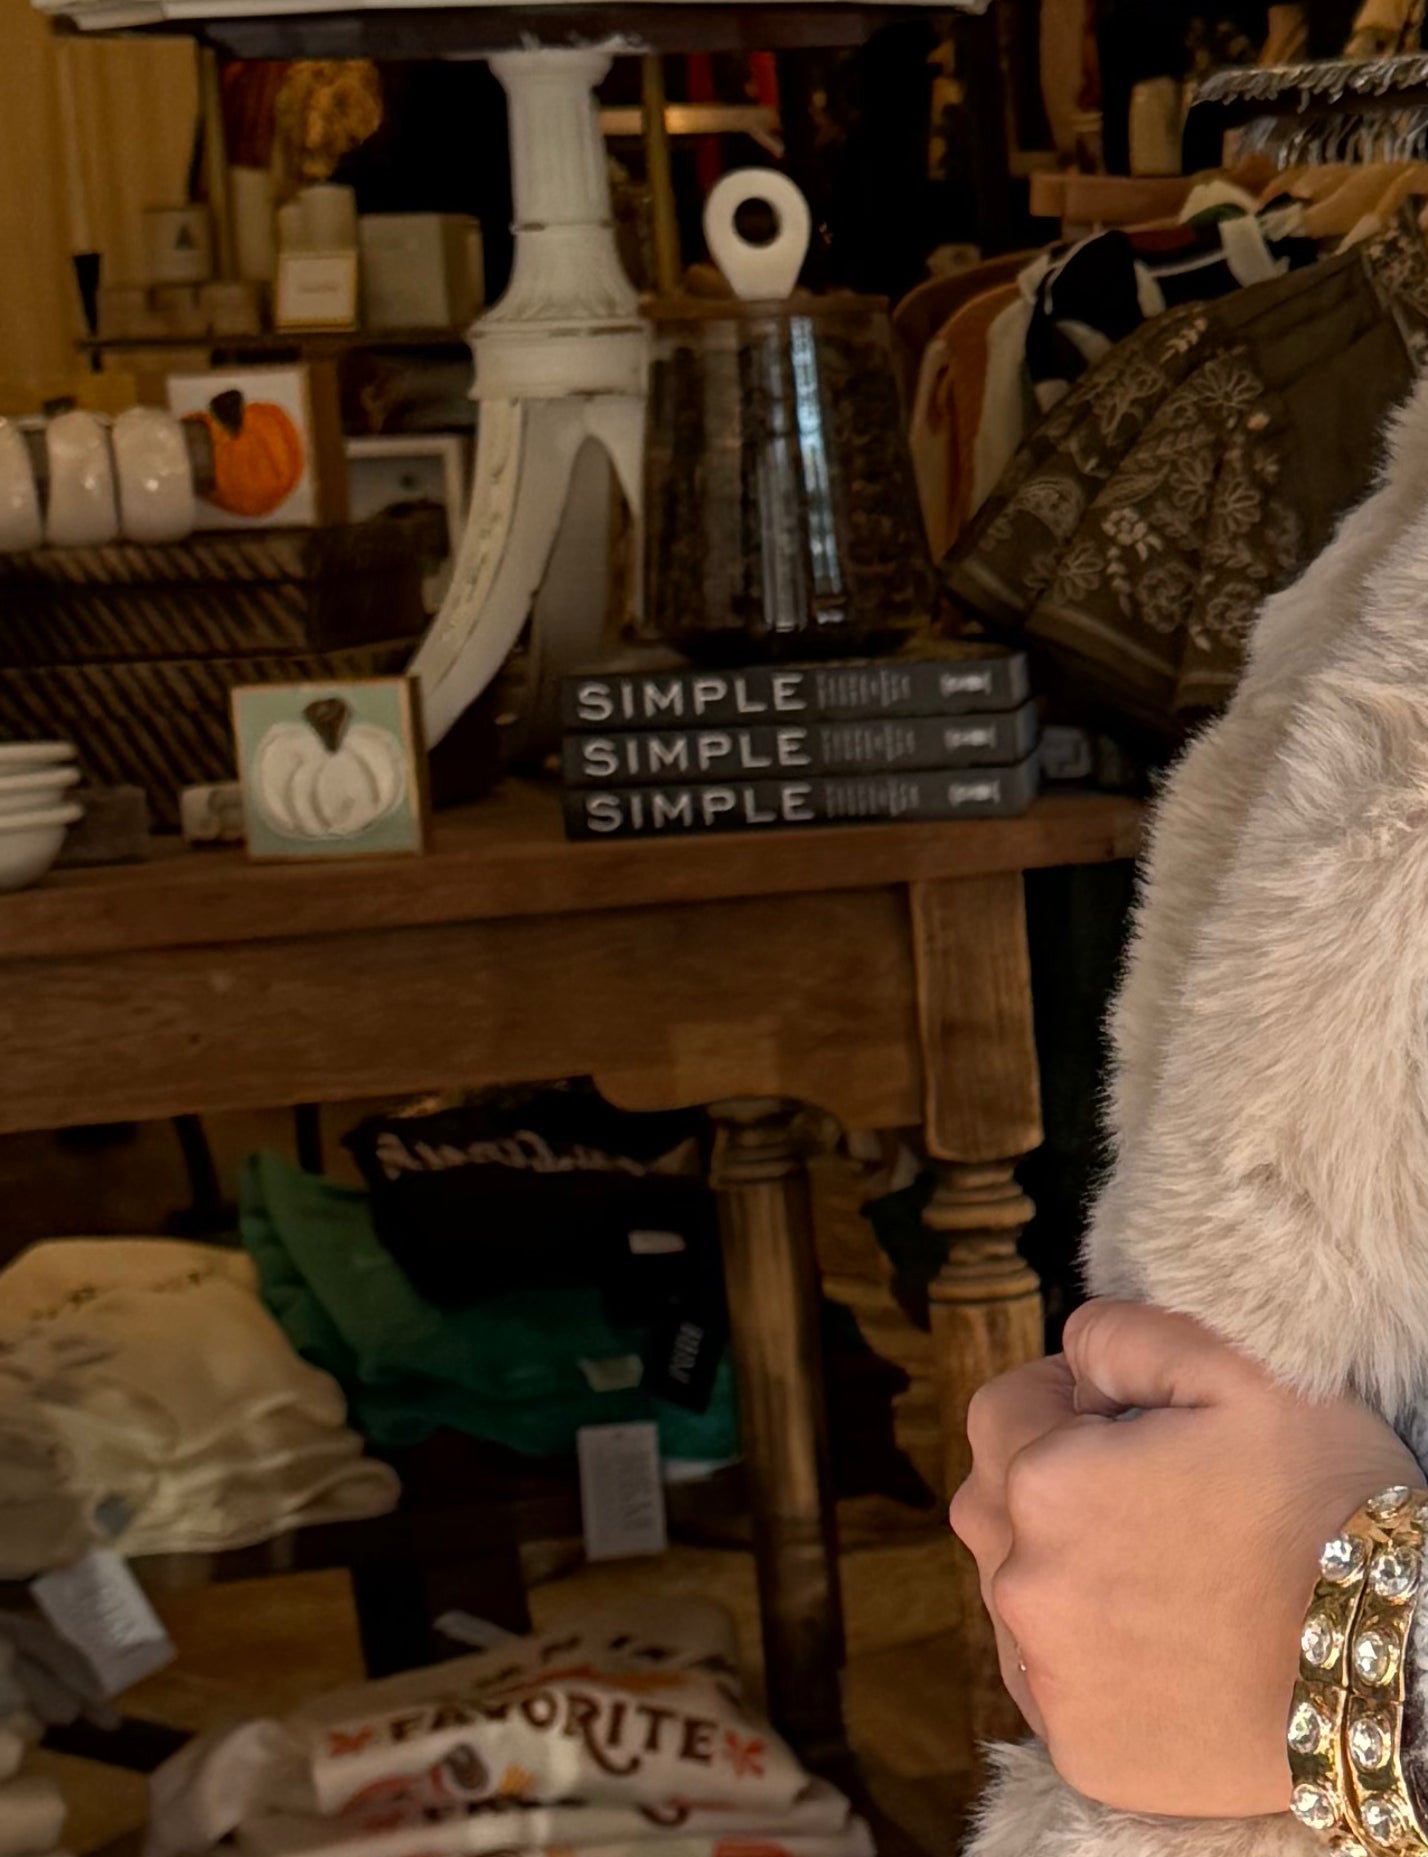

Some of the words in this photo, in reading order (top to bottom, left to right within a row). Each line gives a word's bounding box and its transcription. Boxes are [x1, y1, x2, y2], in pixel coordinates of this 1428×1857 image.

[577, 672, 808, 721] SIMPLE
[582, 727, 813, 778] SIMPLE
[586, 784, 817, 833] SIMPLE
